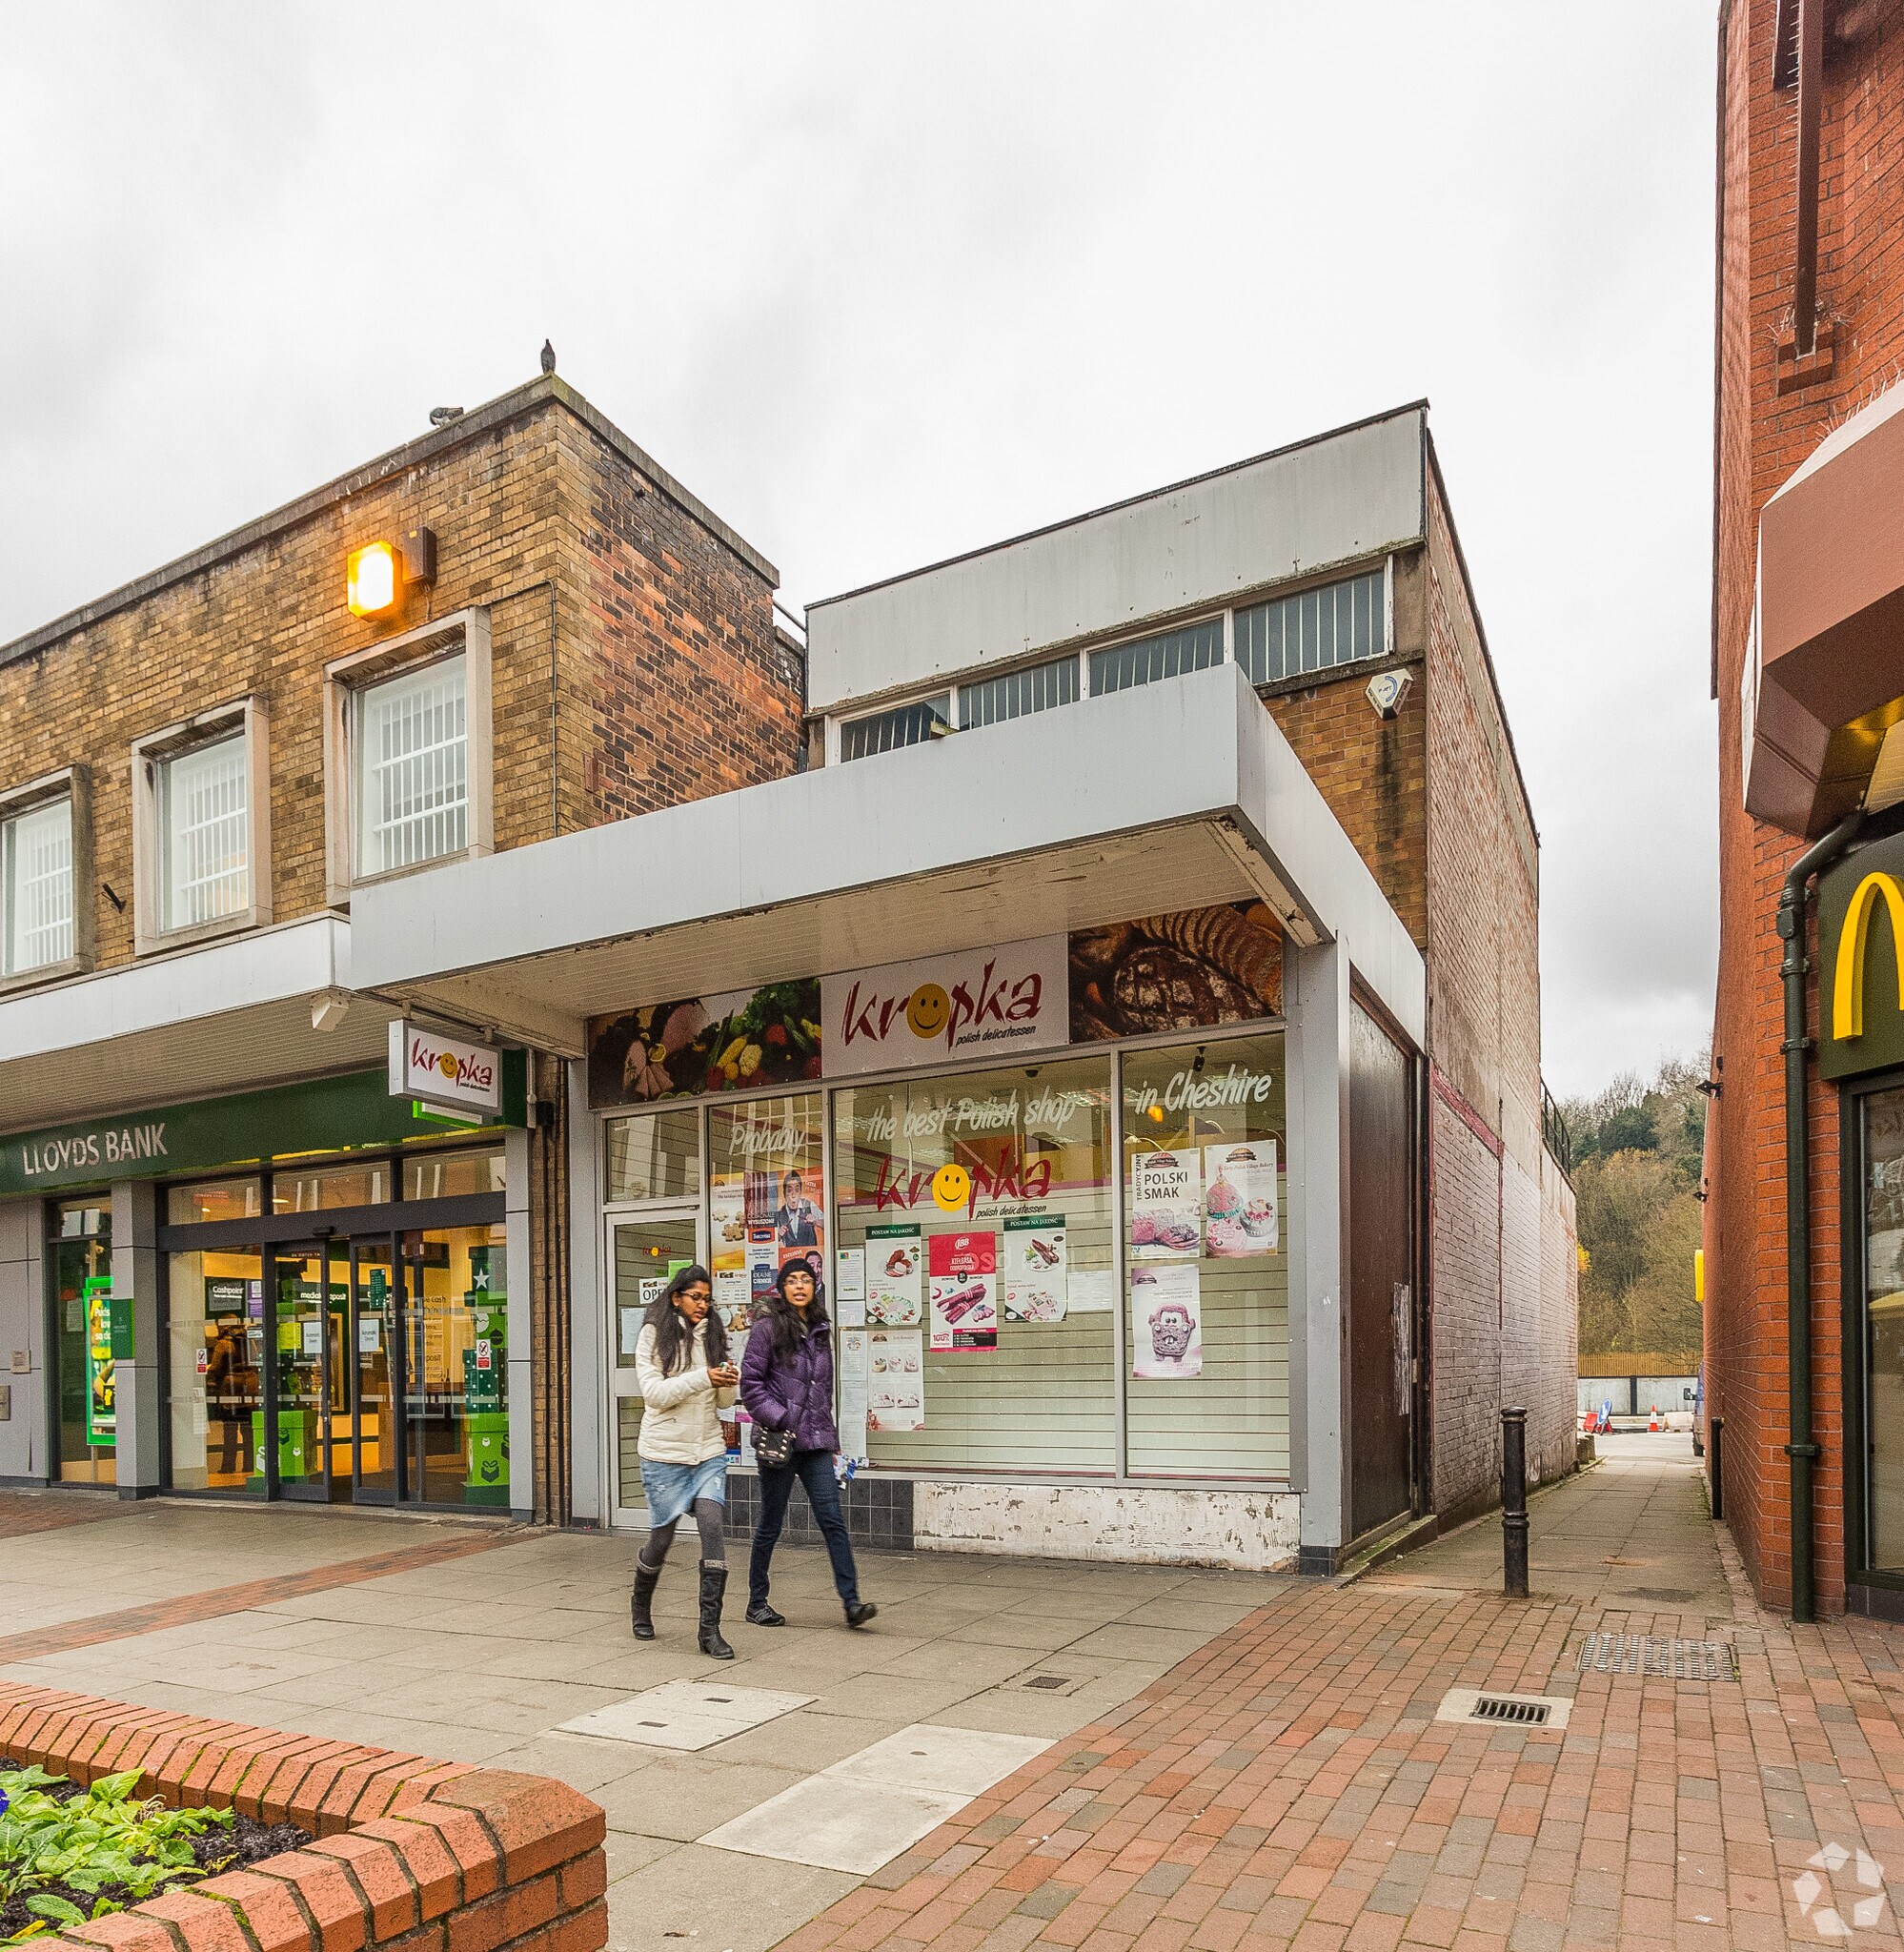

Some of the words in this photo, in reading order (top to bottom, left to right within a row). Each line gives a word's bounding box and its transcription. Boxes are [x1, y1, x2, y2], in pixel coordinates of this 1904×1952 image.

[955, 1031, 981, 1047] polish
[982, 1025, 1037, 1042] delicatessen
[1135, 1080, 1159, 1115] in
[1165, 1064, 1272, 1112] Cheshire
[866, 1105, 897, 1142] the
[903, 1098, 953, 1138] best
[954, 1089, 1020, 1132] Polish
[1023, 1085, 1076, 1132] shop
[23, 1134, 100, 1175] LLOYDS
[105, 1123, 169, 1163] BANK
[728, 1120, 806, 1158] Probably
[1144, 1171, 1188, 1186] POLSKI
[1144, 1187, 1180, 1200] SMAK
[976, 1206, 999, 1220] polish
[999, 1204, 1047, 1217] delicatessen
